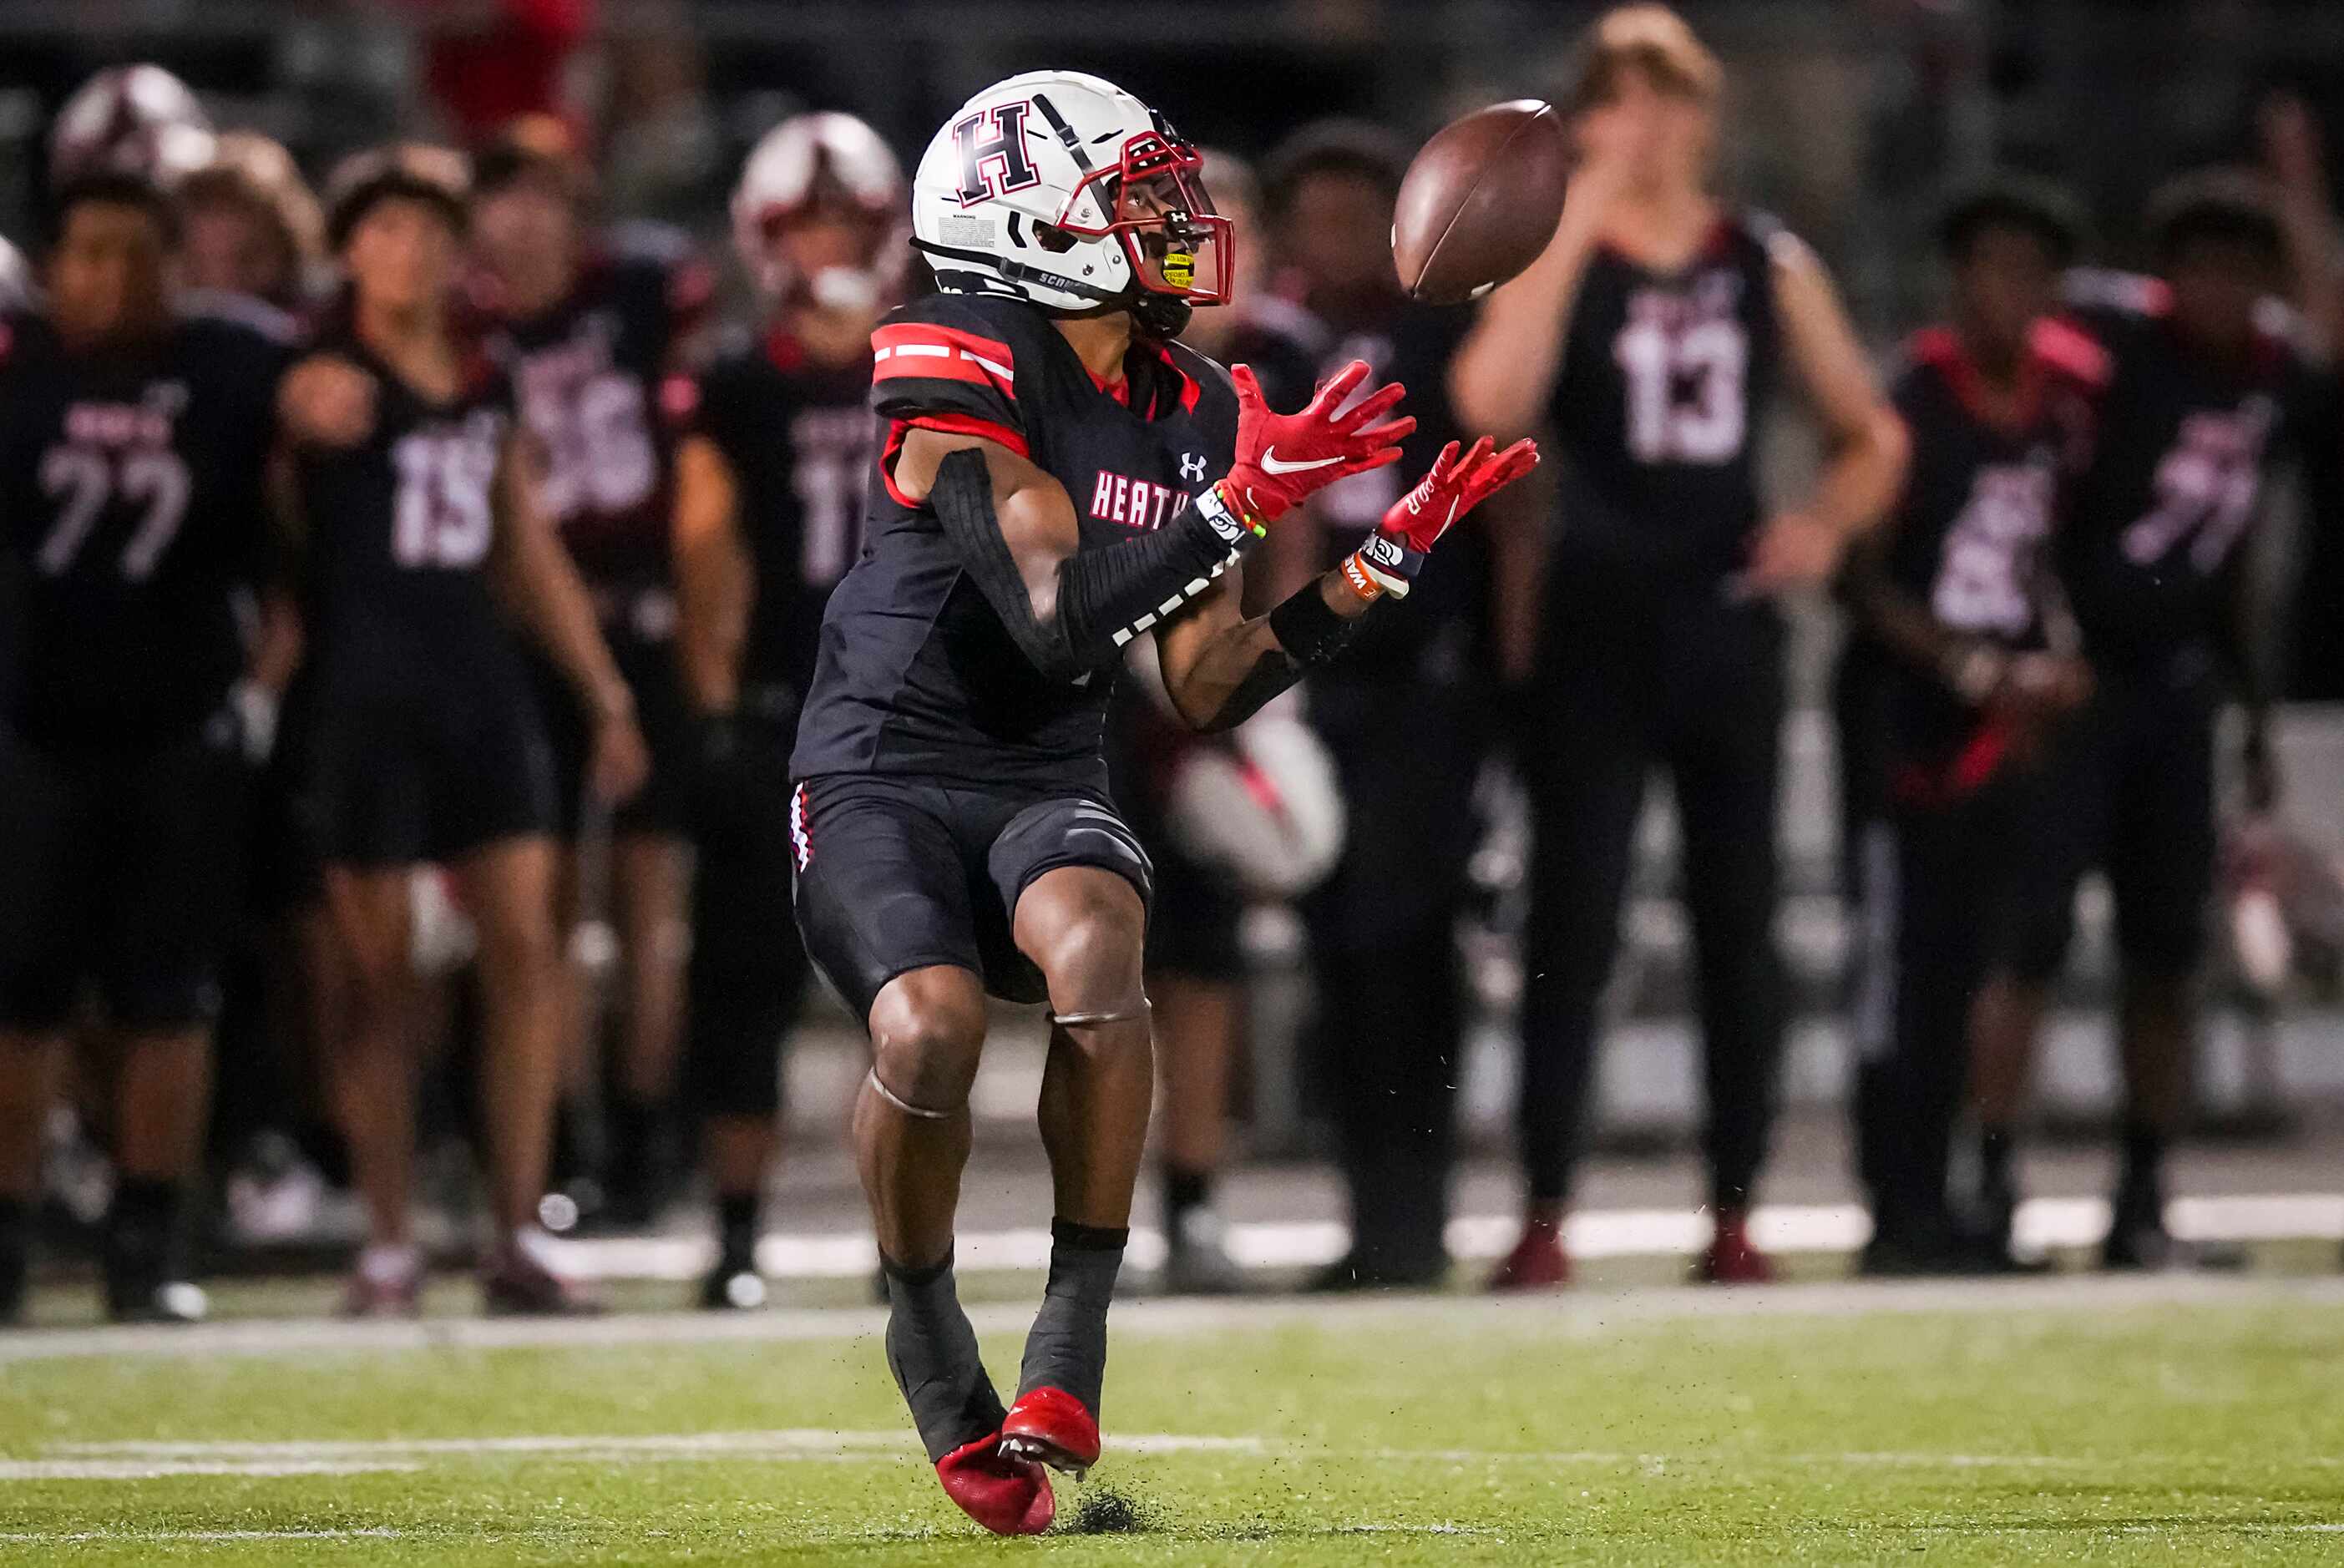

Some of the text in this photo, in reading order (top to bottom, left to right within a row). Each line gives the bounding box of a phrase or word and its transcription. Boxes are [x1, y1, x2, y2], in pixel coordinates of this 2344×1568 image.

[953, 100, 1041, 209] H
[1612, 321, 1749, 464] 13
[37, 443, 195, 582] 77
[389, 430, 494, 572] 15
